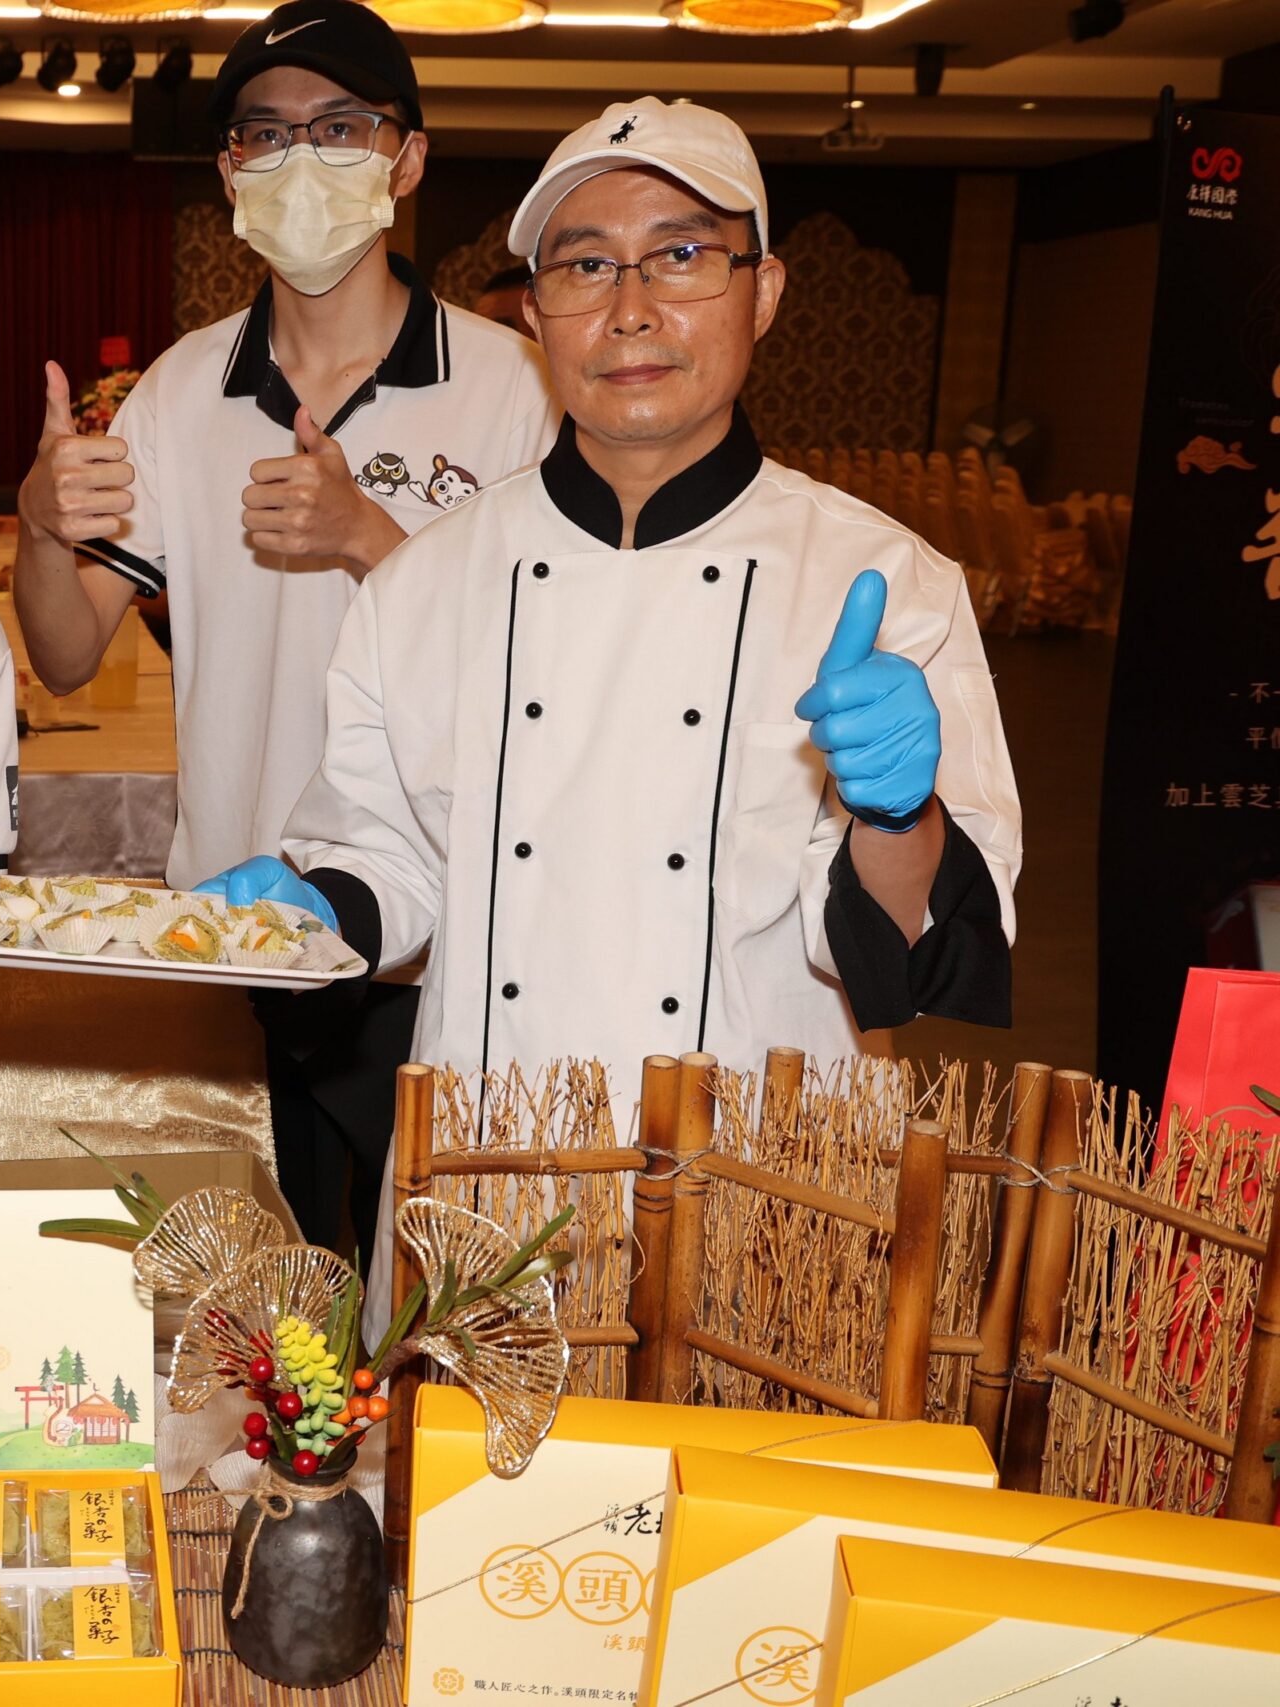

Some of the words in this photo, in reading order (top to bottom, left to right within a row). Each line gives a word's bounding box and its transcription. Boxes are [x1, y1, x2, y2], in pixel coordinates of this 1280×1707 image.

[1164, 782, 1280, 809] 加上雲芝
[624, 1504, 663, 1536] 老
[497, 1560, 633, 1614] 溪頭
